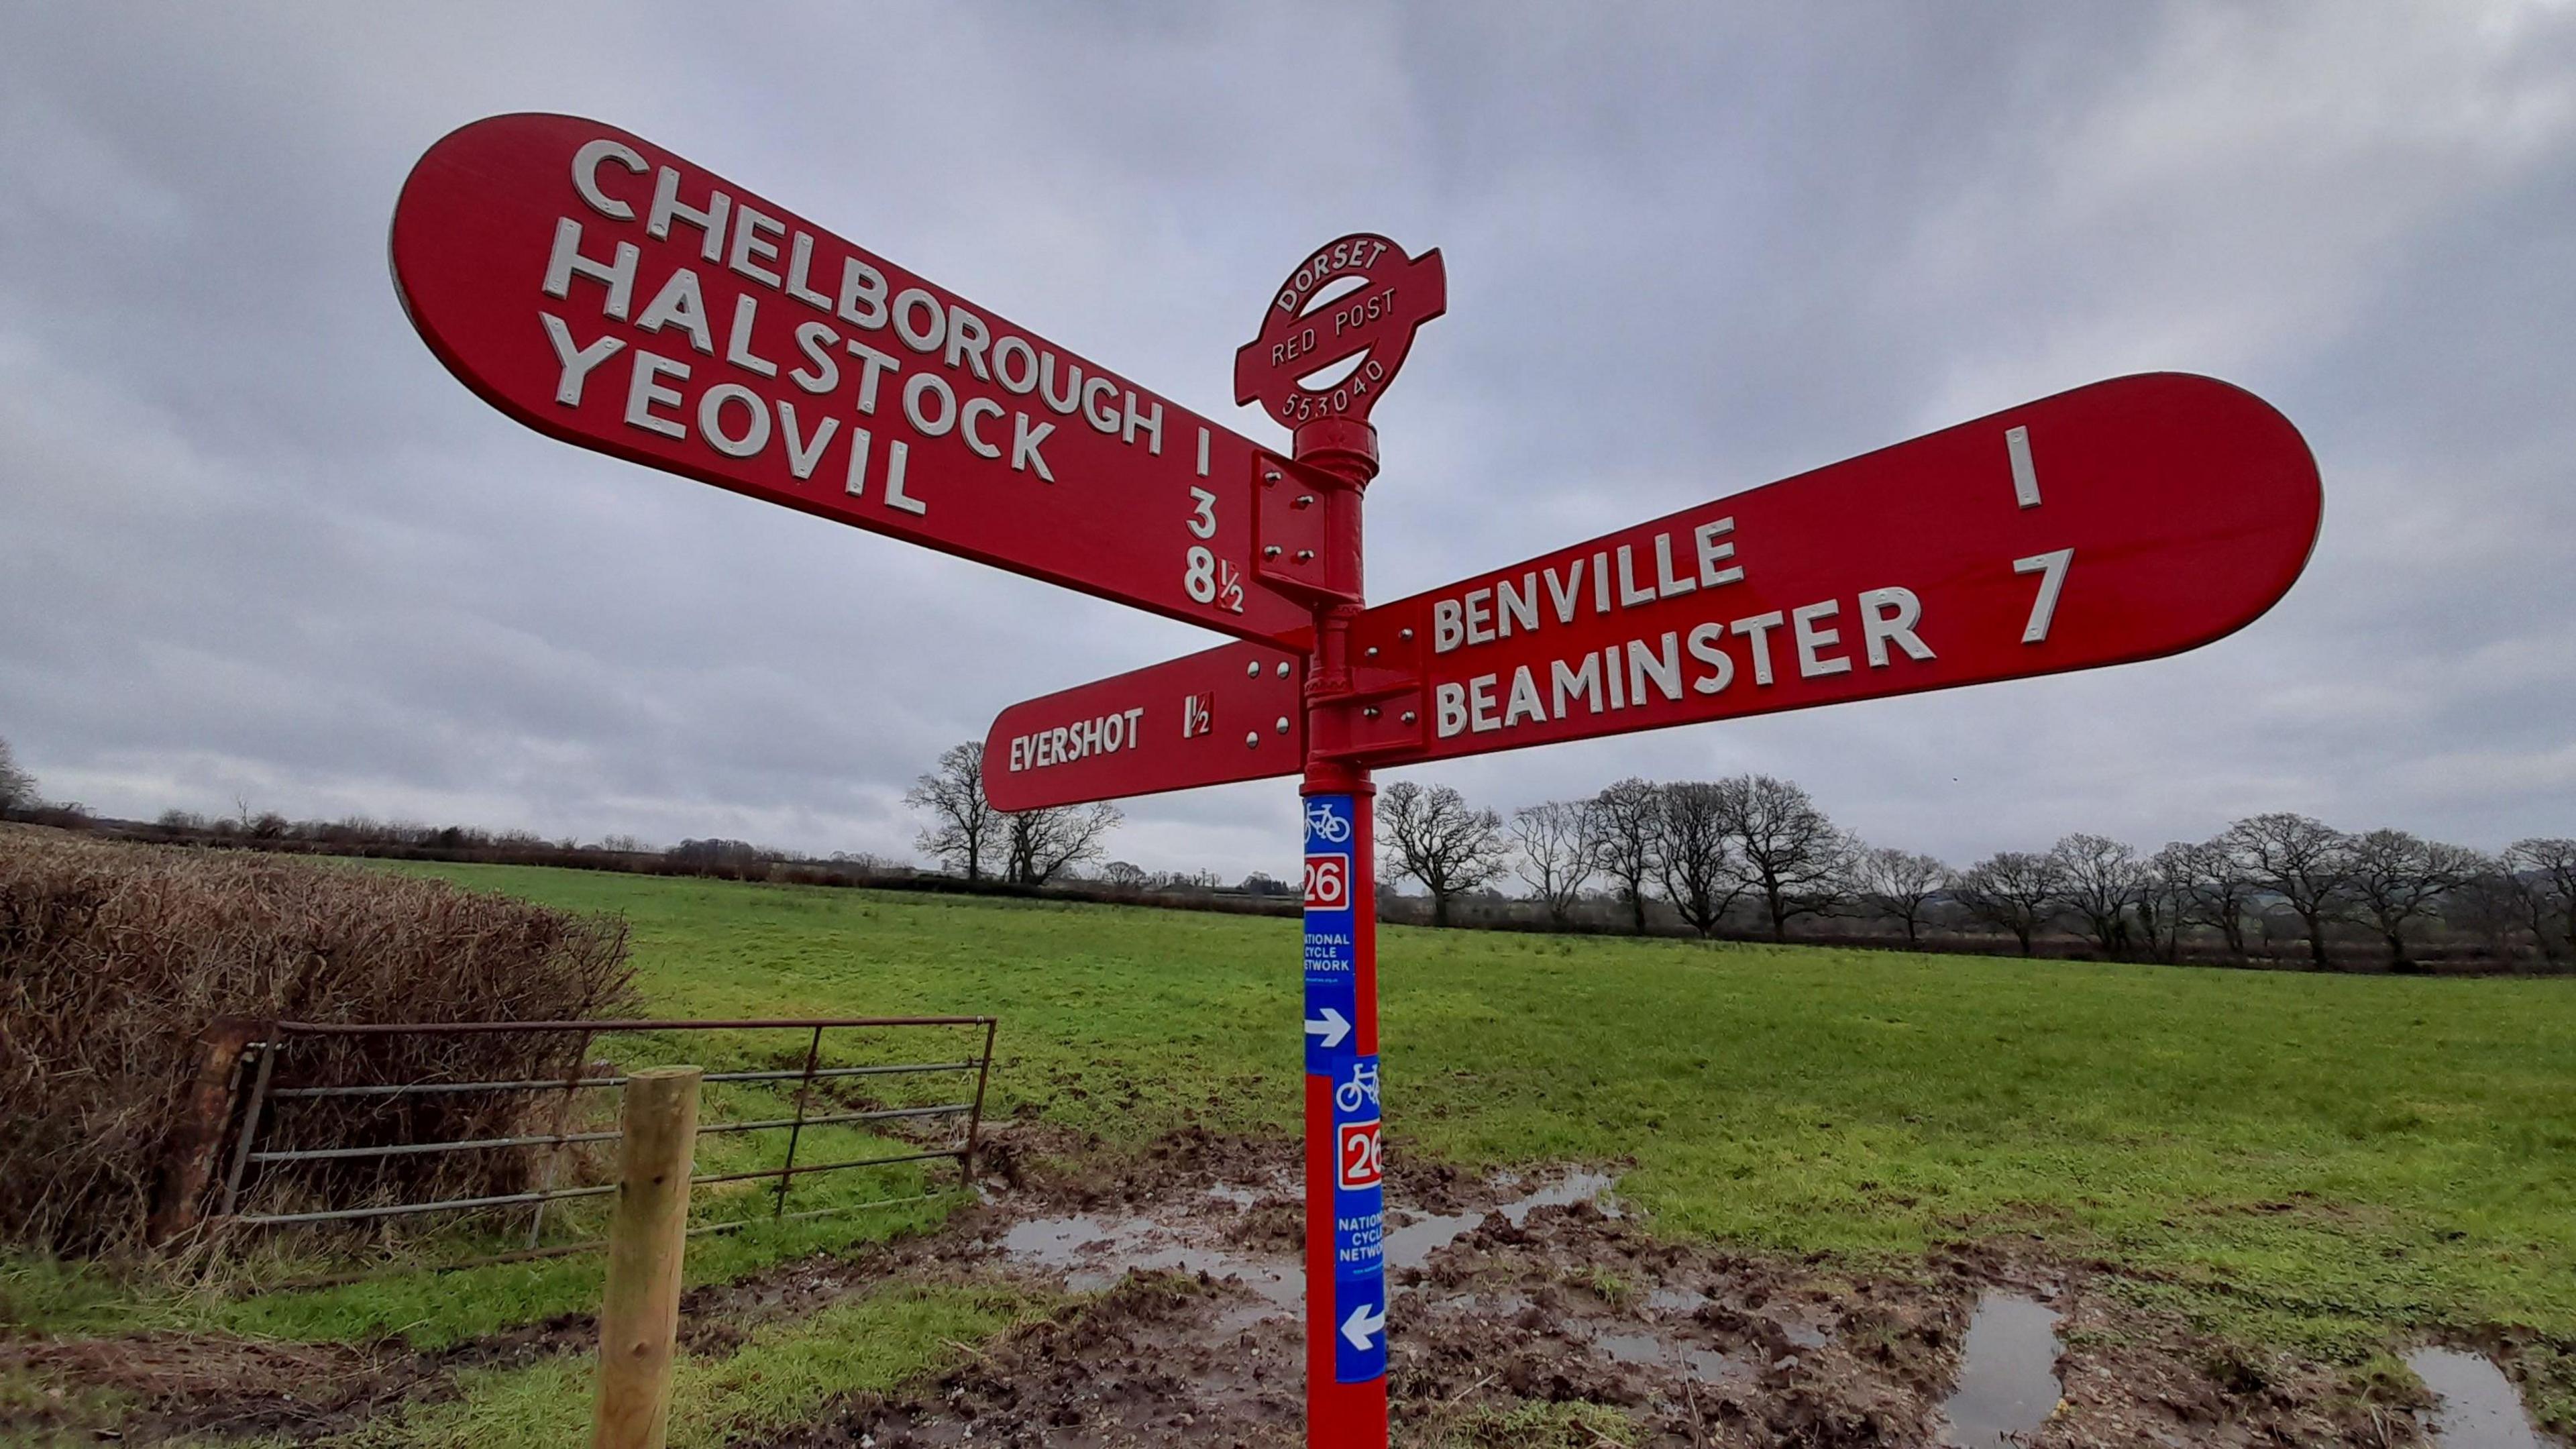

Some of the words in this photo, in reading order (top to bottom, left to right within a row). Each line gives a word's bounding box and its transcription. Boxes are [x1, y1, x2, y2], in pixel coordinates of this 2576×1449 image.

[572, 139, 1163, 455] CHELBOROUGH
[1277, 241, 1387, 312] DORSET
[1272, 328, 1315, 366] RED
[1335, 288, 1395, 335] POST
[539, 311, 927, 516] YEOVIL
[541, 217, 1056, 483] HALSTOCK
[1185, 485, 1218, 539] 3
[1282, 360, 1383, 421] 553040
[1434, 517, 1744, 653] BENVILLE
[1437, 586, 1937, 739] BEAMINSTER
[2013, 547, 2075, 644] 7
[1010, 708, 1144, 772] EVERSHOT
[1305, 862, 1341, 902] 26
[1304, 959, 1350, 971] ETWORK
[1339, 1213, 1382, 1231] NATION
